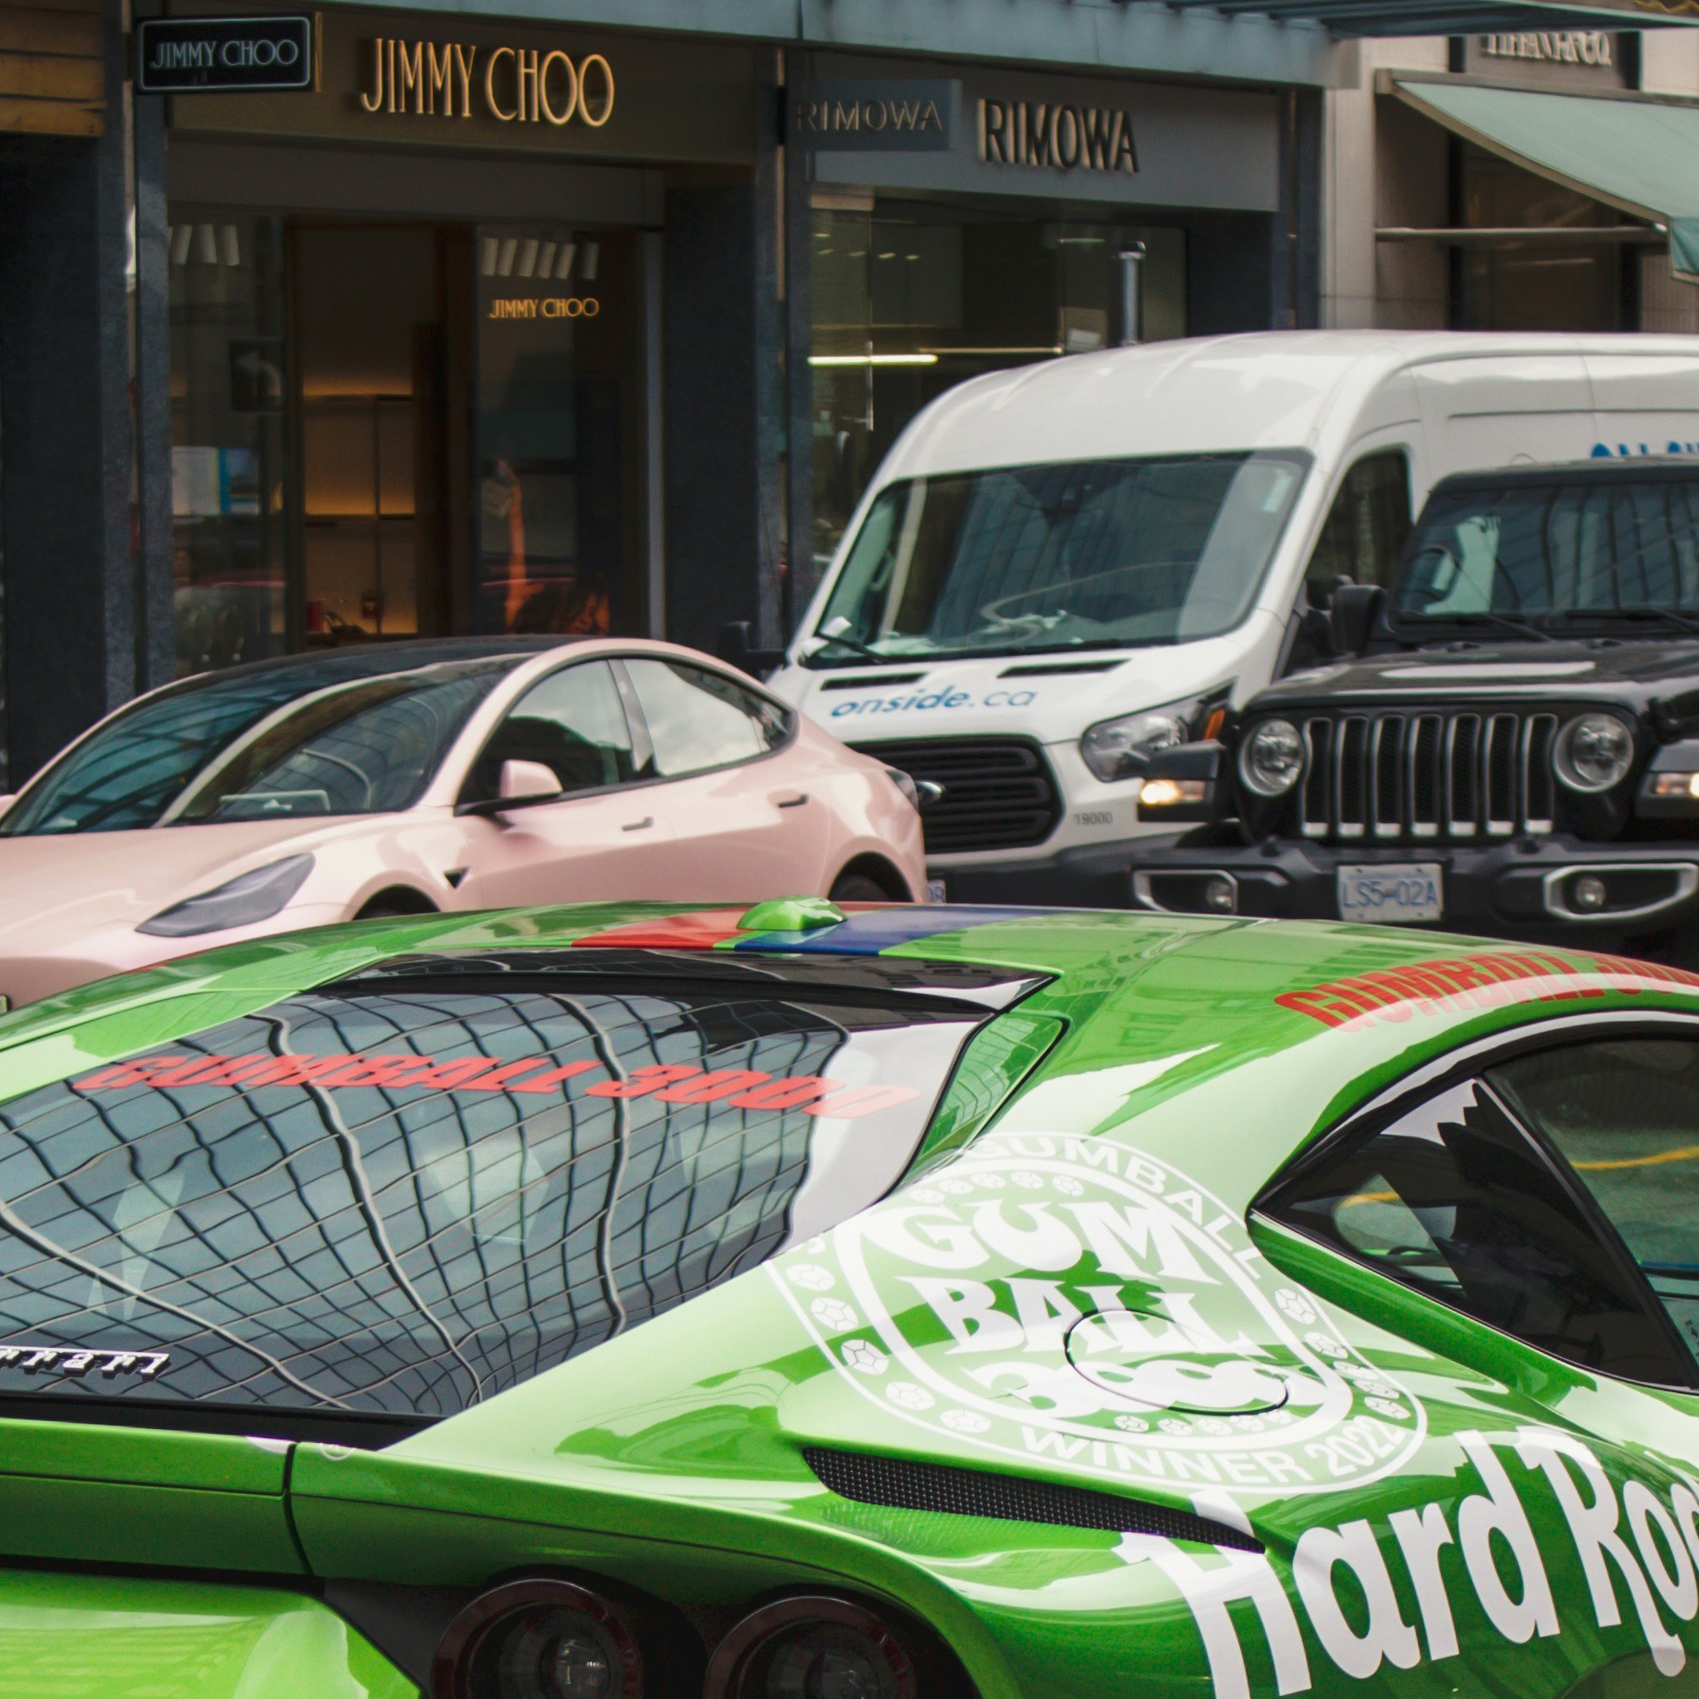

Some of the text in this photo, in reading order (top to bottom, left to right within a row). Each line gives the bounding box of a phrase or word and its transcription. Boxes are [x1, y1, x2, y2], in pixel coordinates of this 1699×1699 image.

[149, 39, 299, 69] JIMMY CHOO
[360, 38, 615, 127] JIMMY CHOO
[797, 100, 944, 132] RIMOWA
[977, 98, 1141, 173] RIMOWA
[488, 297, 599, 319] JIMMY CHOO
[830, 685, 1039, 718] onside.ca
[1274, 949, 1605, 1032] GUMBALL
[73, 1053, 920, 1119] GUMBALL 3000
[1020, 1414, 1409, 1484] WINNER 2022
